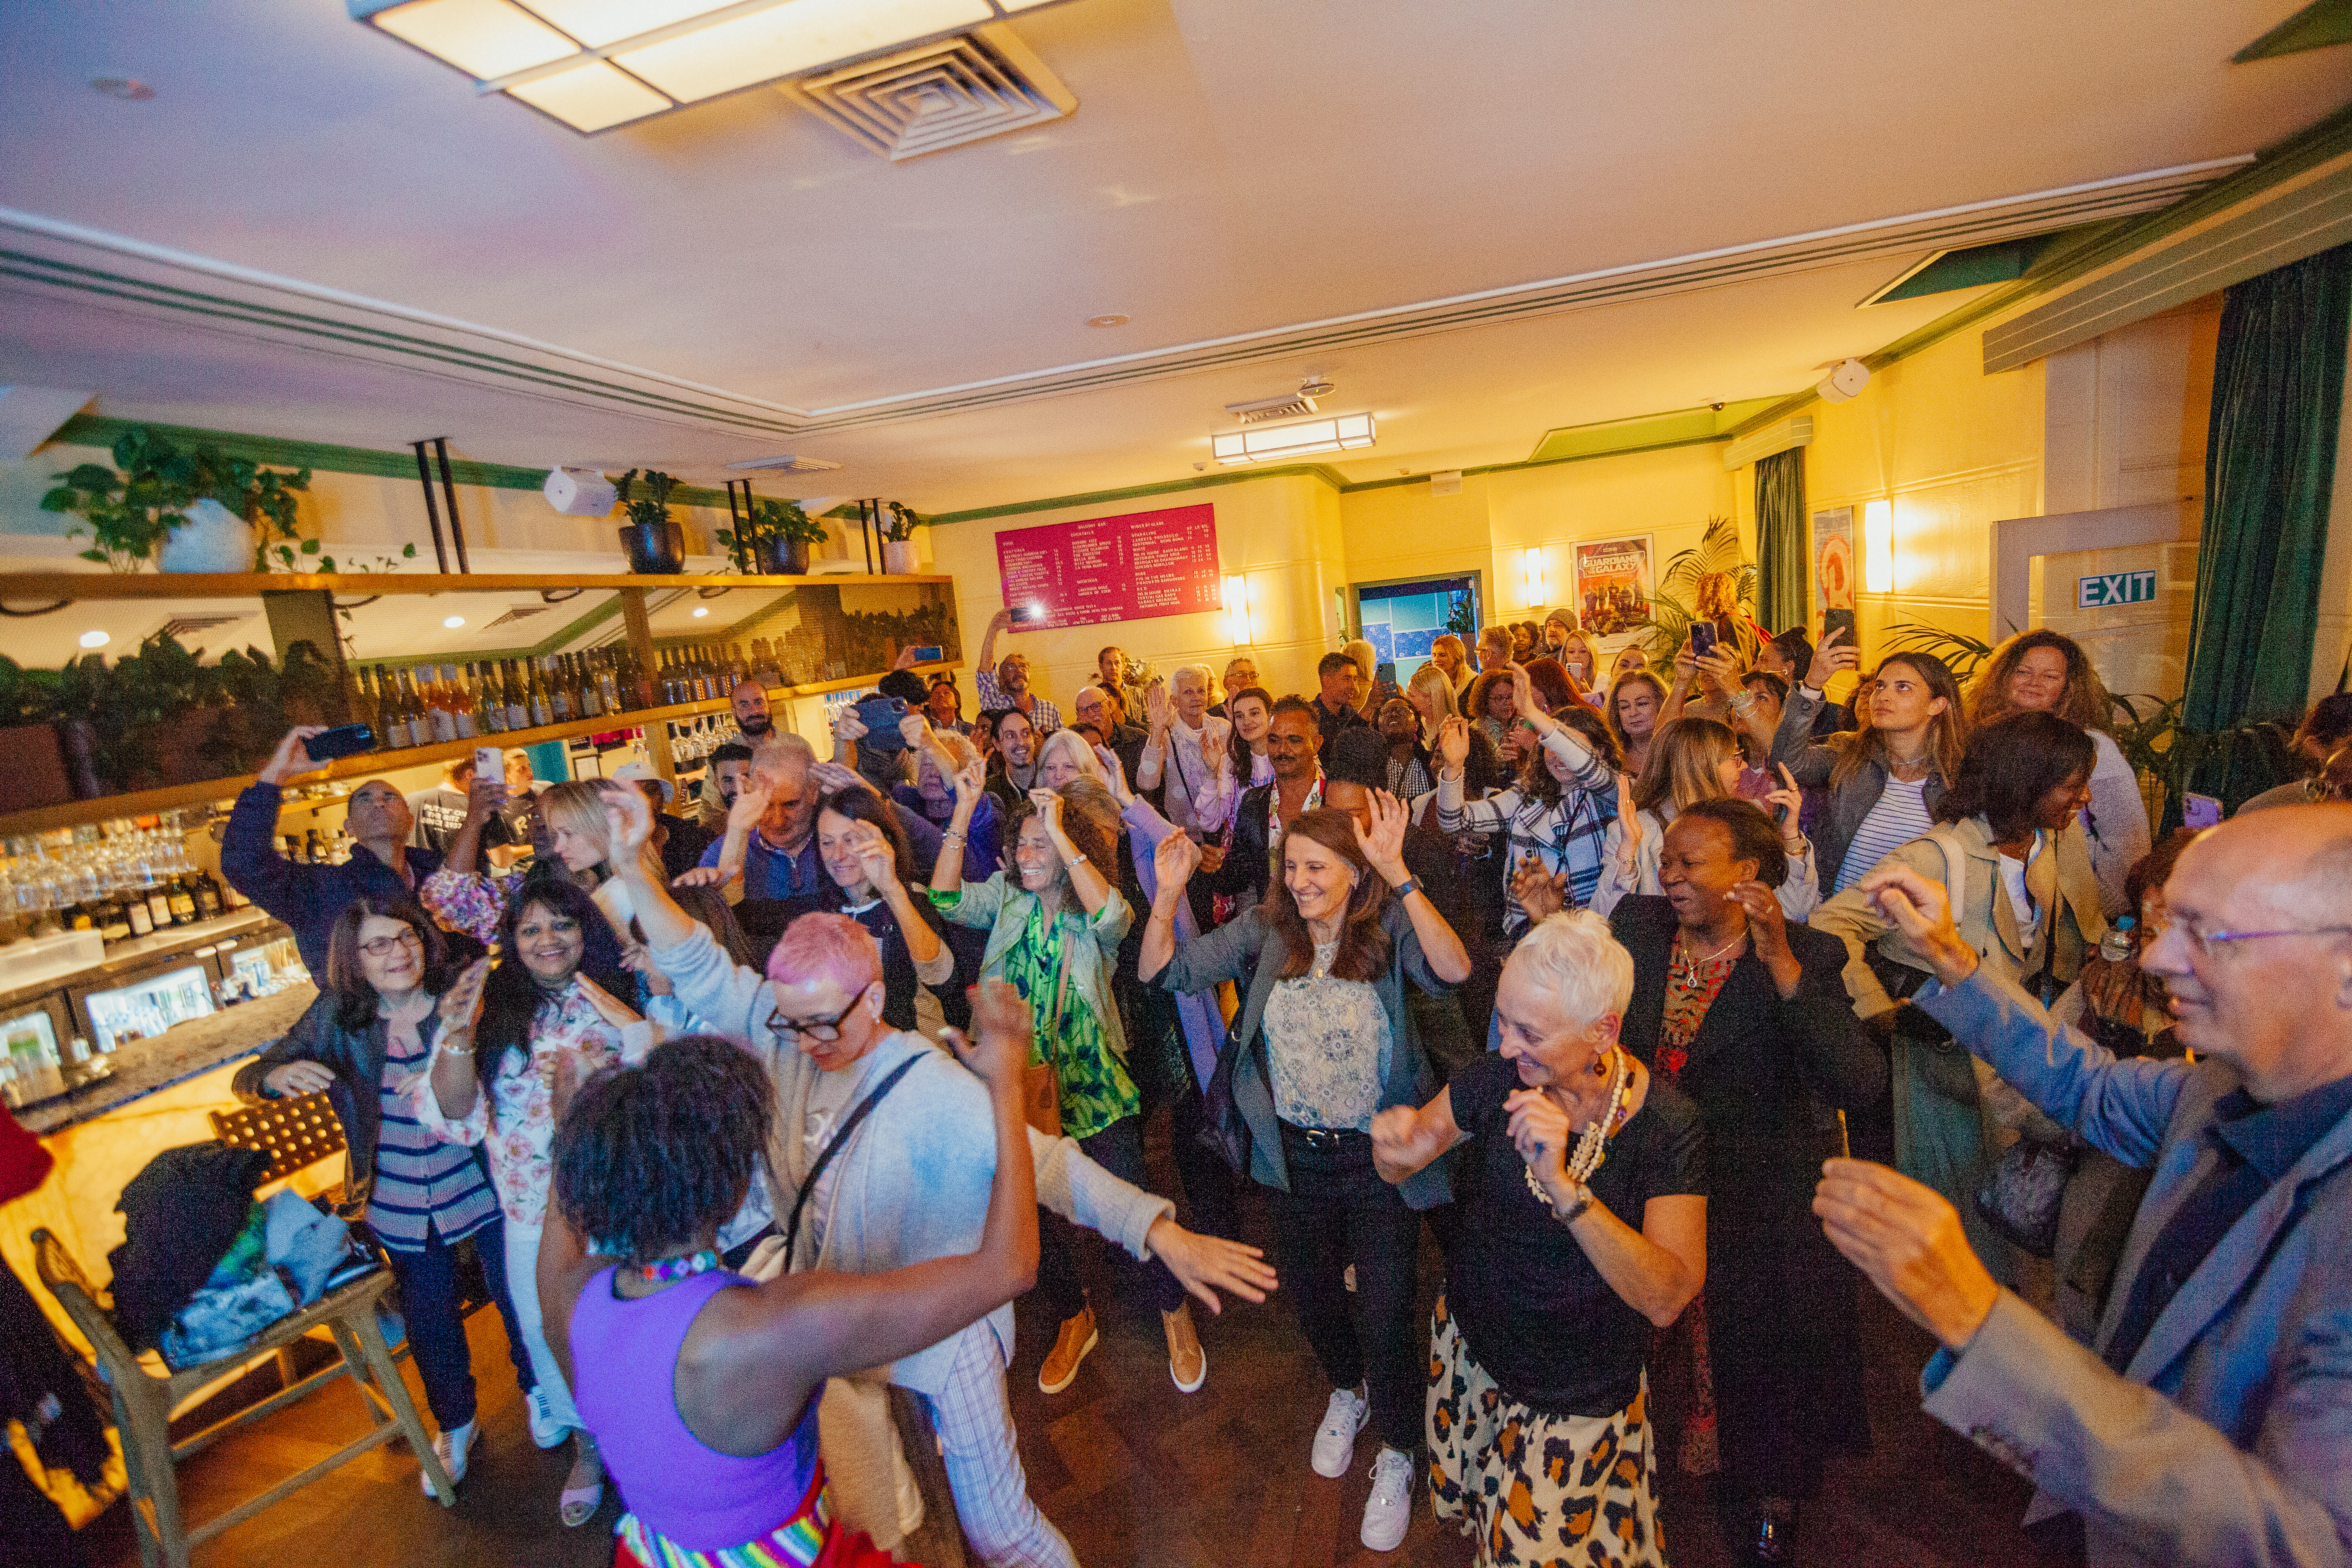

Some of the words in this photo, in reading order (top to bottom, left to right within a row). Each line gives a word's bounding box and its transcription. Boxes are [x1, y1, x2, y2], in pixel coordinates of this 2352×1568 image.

[1583, 554, 1640, 567] GUARDIANS
[1596, 562, 1637, 574] GALAXY
[2081, 573, 2155, 606] EXIT
[420, 818, 443, 826] SINCE
